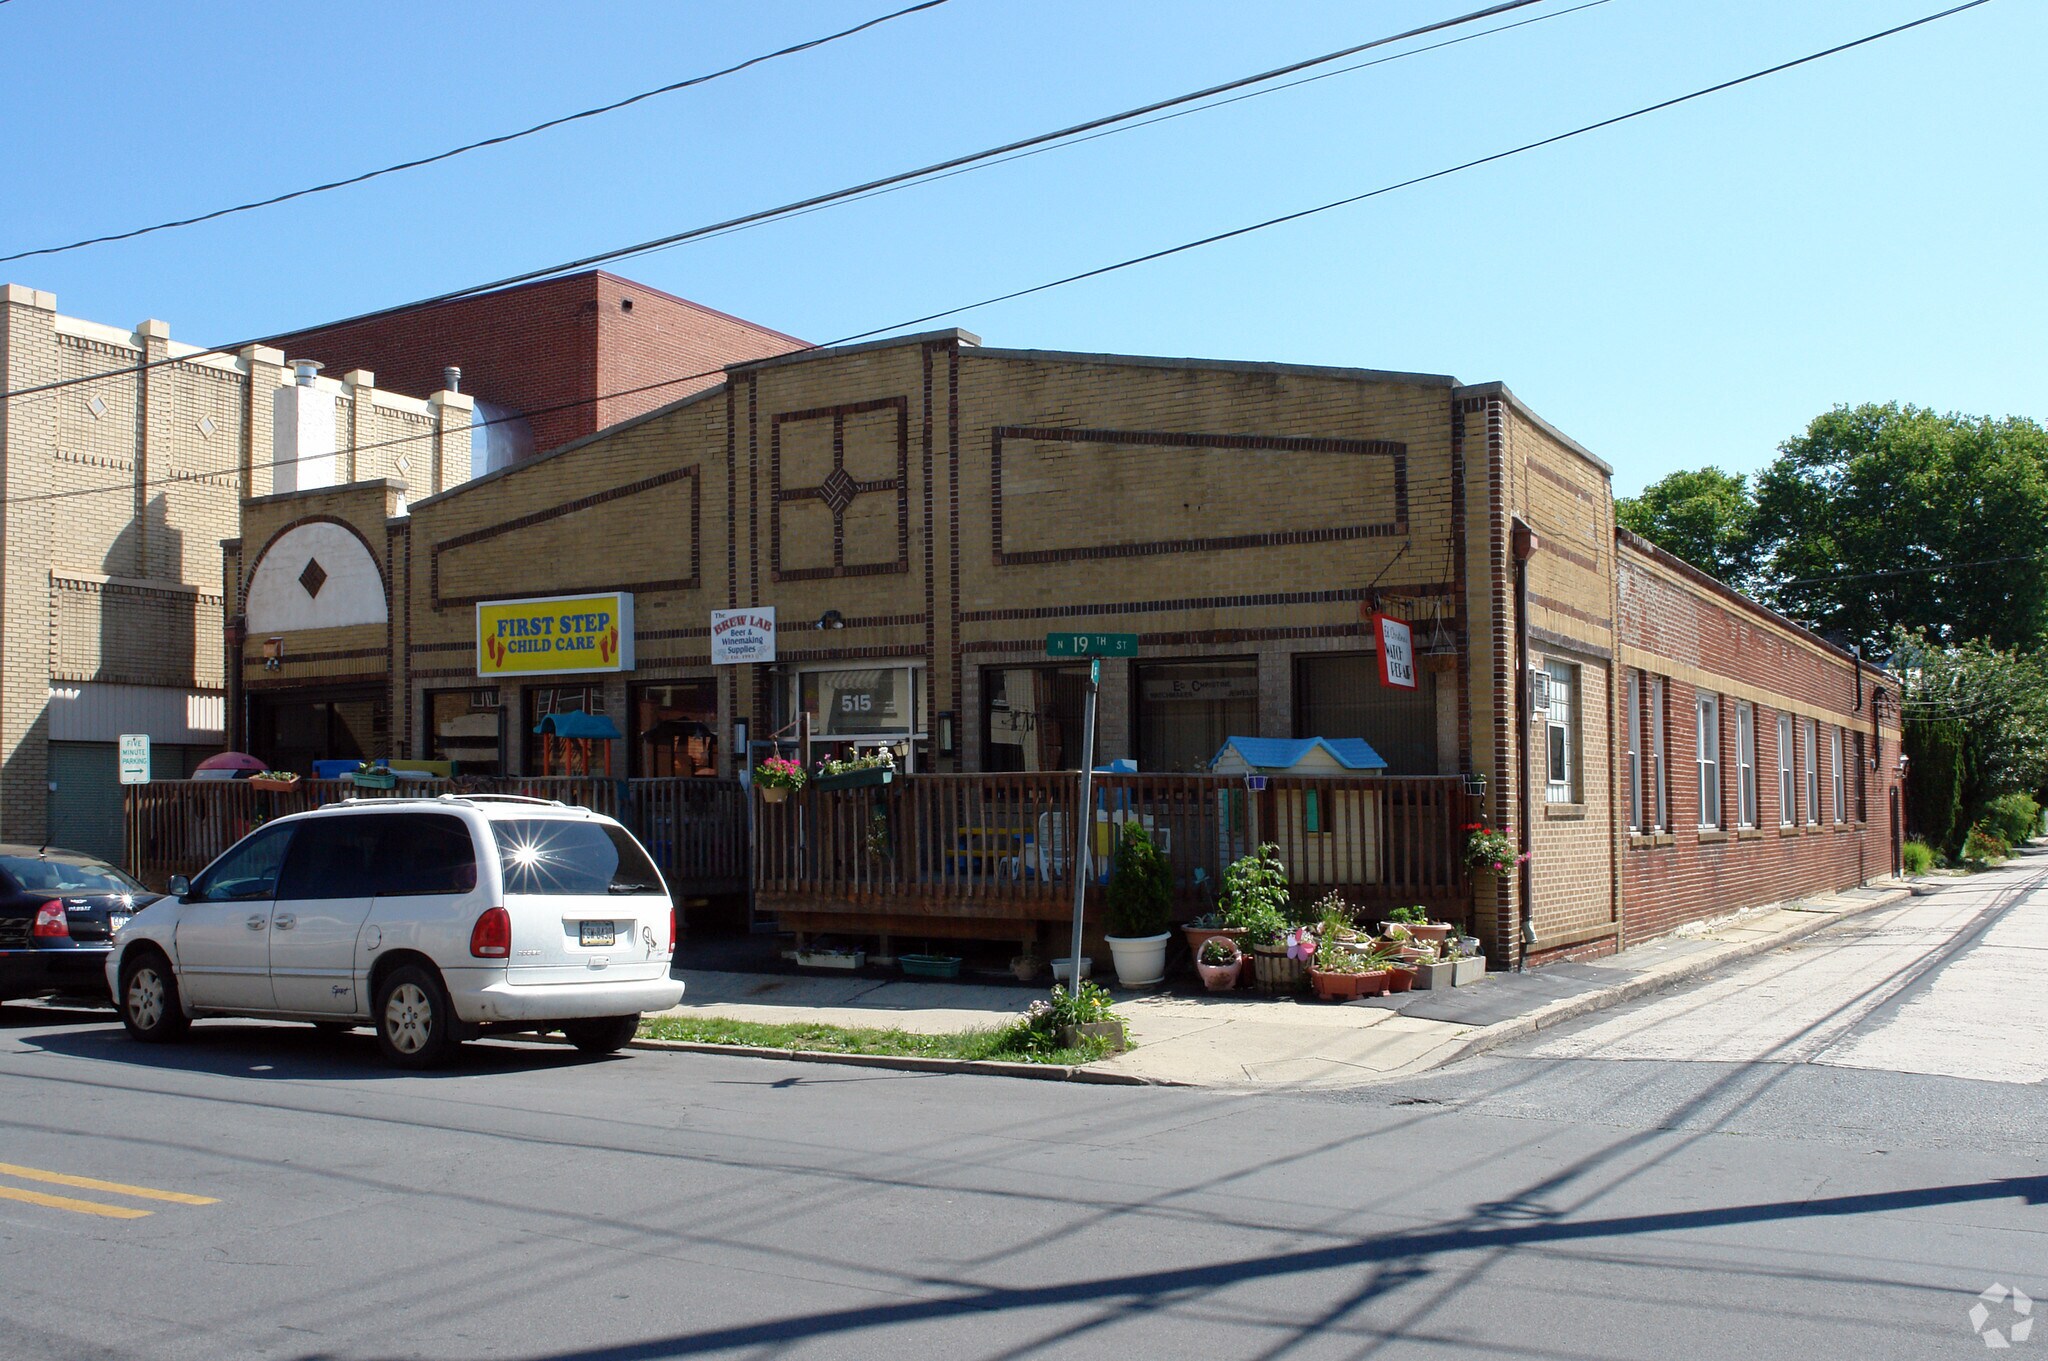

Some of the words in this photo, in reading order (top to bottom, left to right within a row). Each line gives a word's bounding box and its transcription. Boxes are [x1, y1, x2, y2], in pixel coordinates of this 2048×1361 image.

[497, 616, 554, 637] FIRST
[560, 613, 609, 634] STEP
[713, 615, 747, 636] BREW
[749, 615, 772, 632] LAB
[731, 629, 745, 637] Beer
[508, 638, 551, 653] CHILD
[556, 636, 595, 651] CARE
[722, 636, 763, 645] Winemaking
[1057, 641, 1063, 649] N
[1073, 636, 1088, 653] 19
[1096, 636, 1106, 645] TH
[1116, 641, 1127, 650] ST
[727, 645, 756, 655] Supplies
[841, 694, 871, 712] 515
